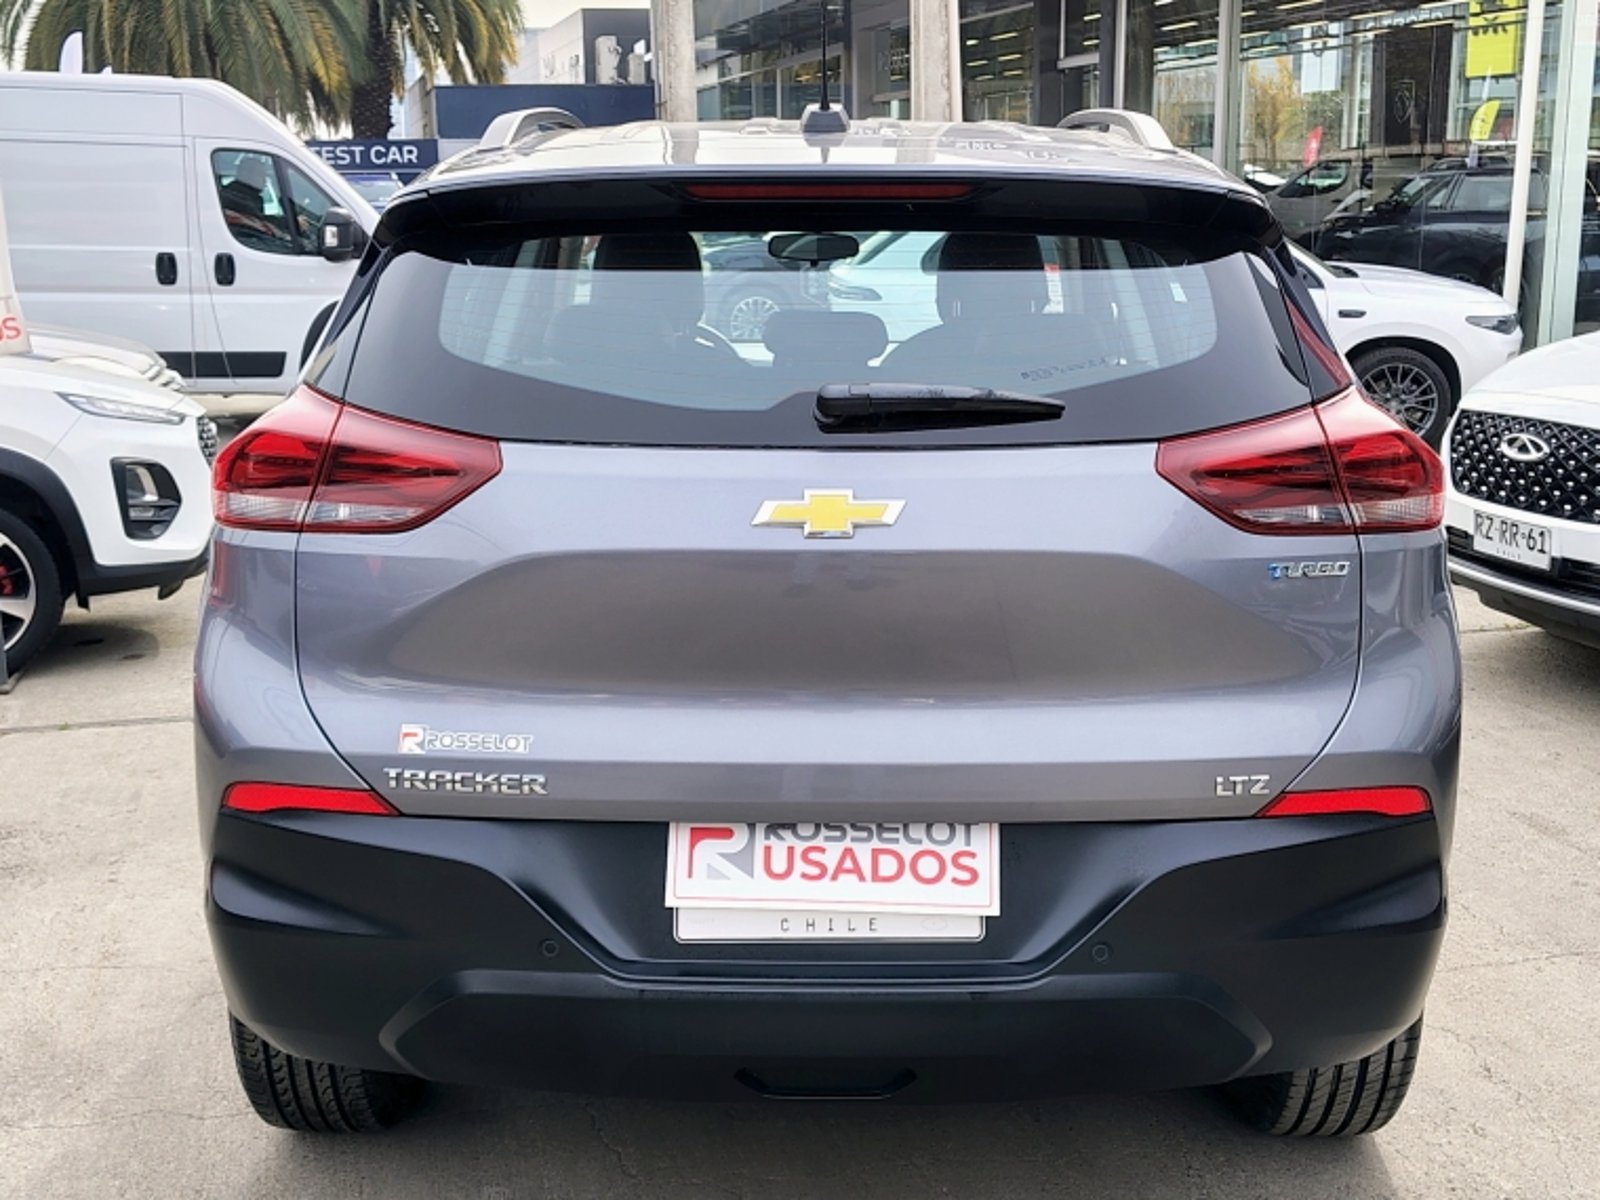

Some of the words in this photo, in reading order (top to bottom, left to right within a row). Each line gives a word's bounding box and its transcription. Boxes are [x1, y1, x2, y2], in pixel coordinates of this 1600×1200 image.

[369, 145, 418, 165] CAR
[1475, 512, 1547, 554] RZ-RR-61
[426, 731, 533, 752] ROSSELOT
[384, 768, 548, 795] TRACKER
[1215, 775, 1270, 796] LTZ
[762, 823, 979, 847] ROSSELOT
[763, 845, 980, 887] USADOS
[780, 917, 880, 932] CHILE
